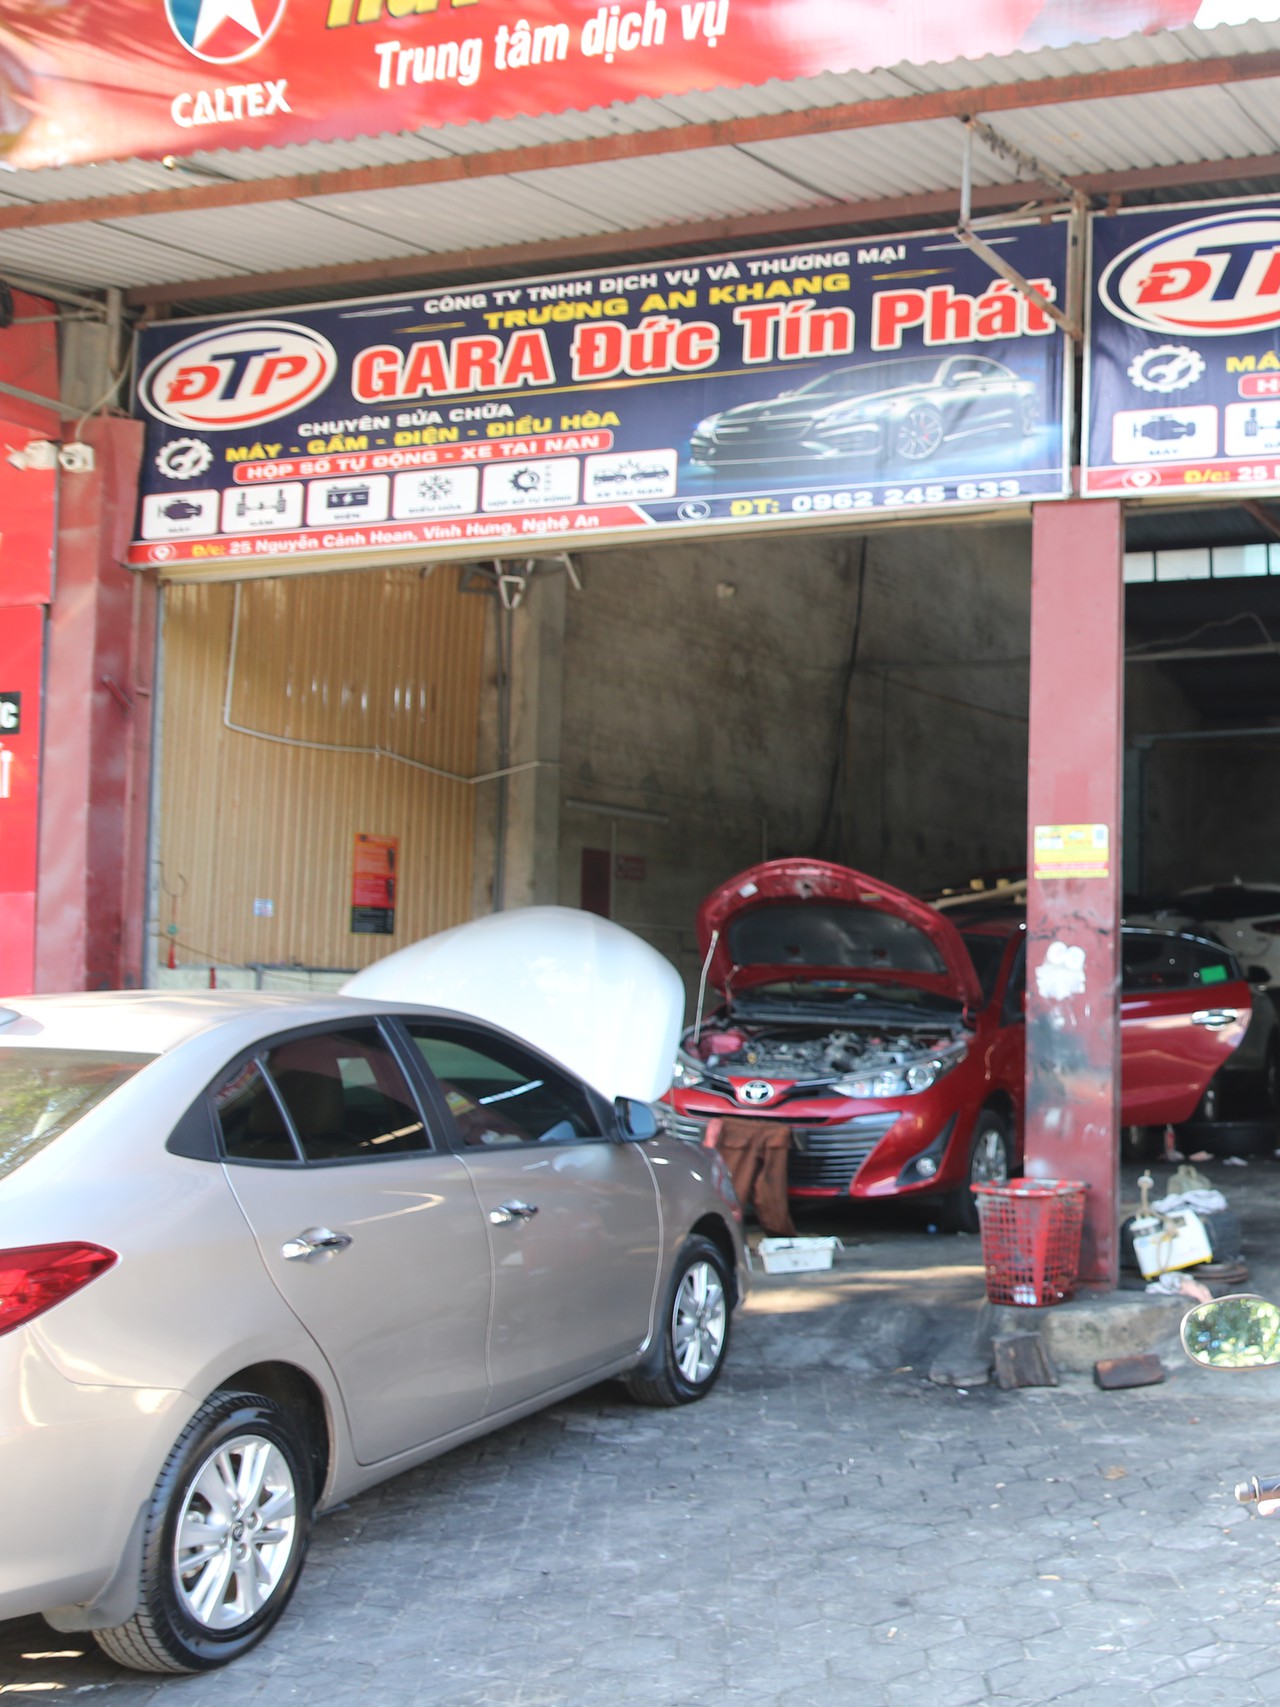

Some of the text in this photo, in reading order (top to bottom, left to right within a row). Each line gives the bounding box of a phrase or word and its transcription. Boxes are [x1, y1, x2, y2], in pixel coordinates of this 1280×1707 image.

[374, 0, 730, 89] Trung tâm dịch vụ
[170, 78, 292, 129] CALTEX
[424, 244, 906, 314] CÔNG TY TNHH DỊCH VỤ VÀ THƯƠNG MẠI
[483, 273, 850, 330] TRƯỜNG AN KHANG
[351, 278, 1057, 404] GARA Đức Tín Phát
[166, 347, 308, 403] ĐTP
[225, 441, 282, 463] MÁY
[393, 425, 459, 450] ĐIỆN
[560, 410, 621, 431] HÒA
[298, 401, 515, 437] CHUYÊN SỬA CHỮA
[247, 462, 293, 481] HỘP
[299, 453, 331, 475] SỐ
[336, 454, 367, 473] TỰ
[372, 449, 438, 472] ĐỘNG
[461, 445, 492, 461] XE
[499, 440, 541, 457] TAI
[545, 434, 600, 455] NẠN
[1237, 465, 1268, 481] 25
[730, 478, 1020, 517] ĐT: 0962 245 633
[229, 541, 252, 554] 25
[255, 533, 319, 555] Nguyễn
[423, 520, 461, 540] Vinh
[575, 512, 600, 529] An
